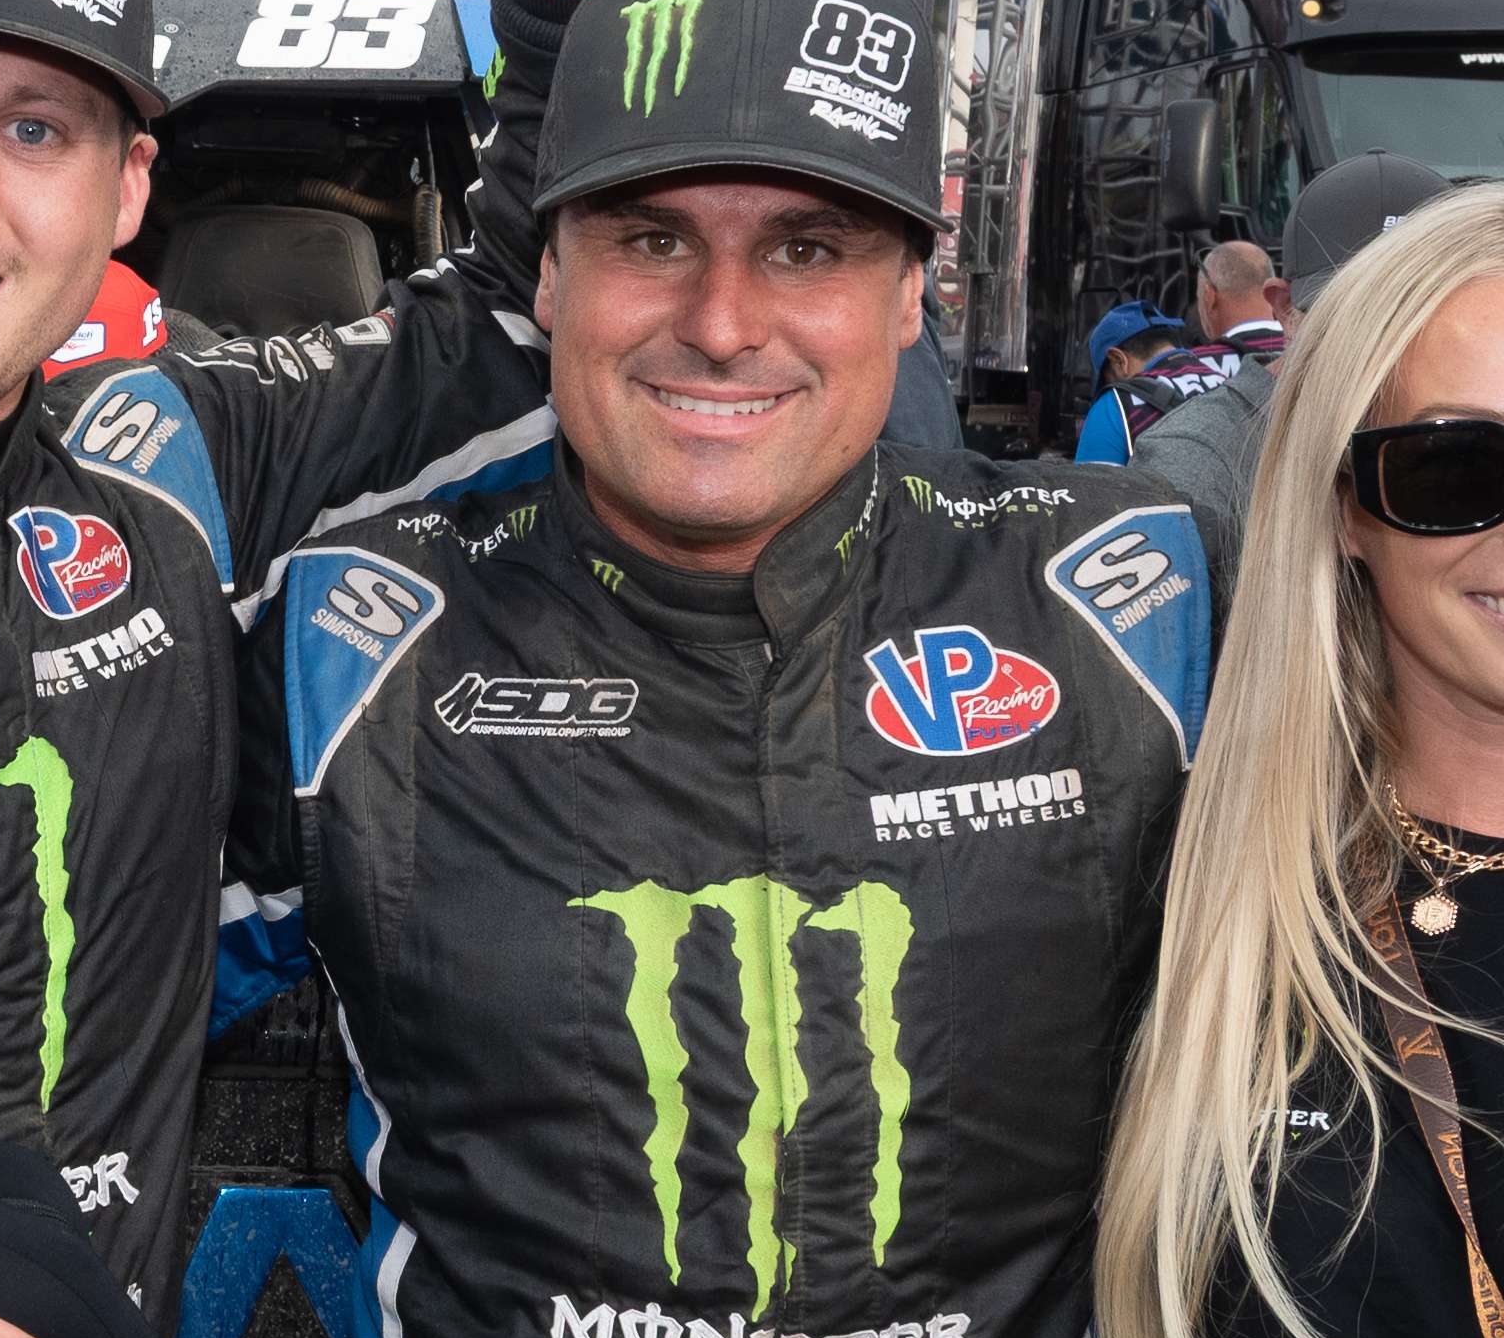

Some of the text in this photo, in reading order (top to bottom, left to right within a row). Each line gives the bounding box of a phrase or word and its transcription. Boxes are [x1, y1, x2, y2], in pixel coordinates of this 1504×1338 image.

[784, 65, 912, 126] BFGoodrich
[132, 418, 179, 475] SIMPSON
[60, 541, 126, 588] Racing
[1111, 576, 1187, 634] SIMPSON
[310, 607, 381, 660] SIMPSON
[35, 674, 89, 699] RACE
[469, 677, 640, 724] SDG
[863, 623, 996, 757] VP
[961, 681, 1058, 729] Racing
[469, 724, 529, 737] SUSPENSION
[598, 725, 632, 738] GROUP
[965, 722, 1042, 742] FUELS
[869, 767, 1086, 828] METHOD
[875, 798, 1087, 843] RACE WHEELS
